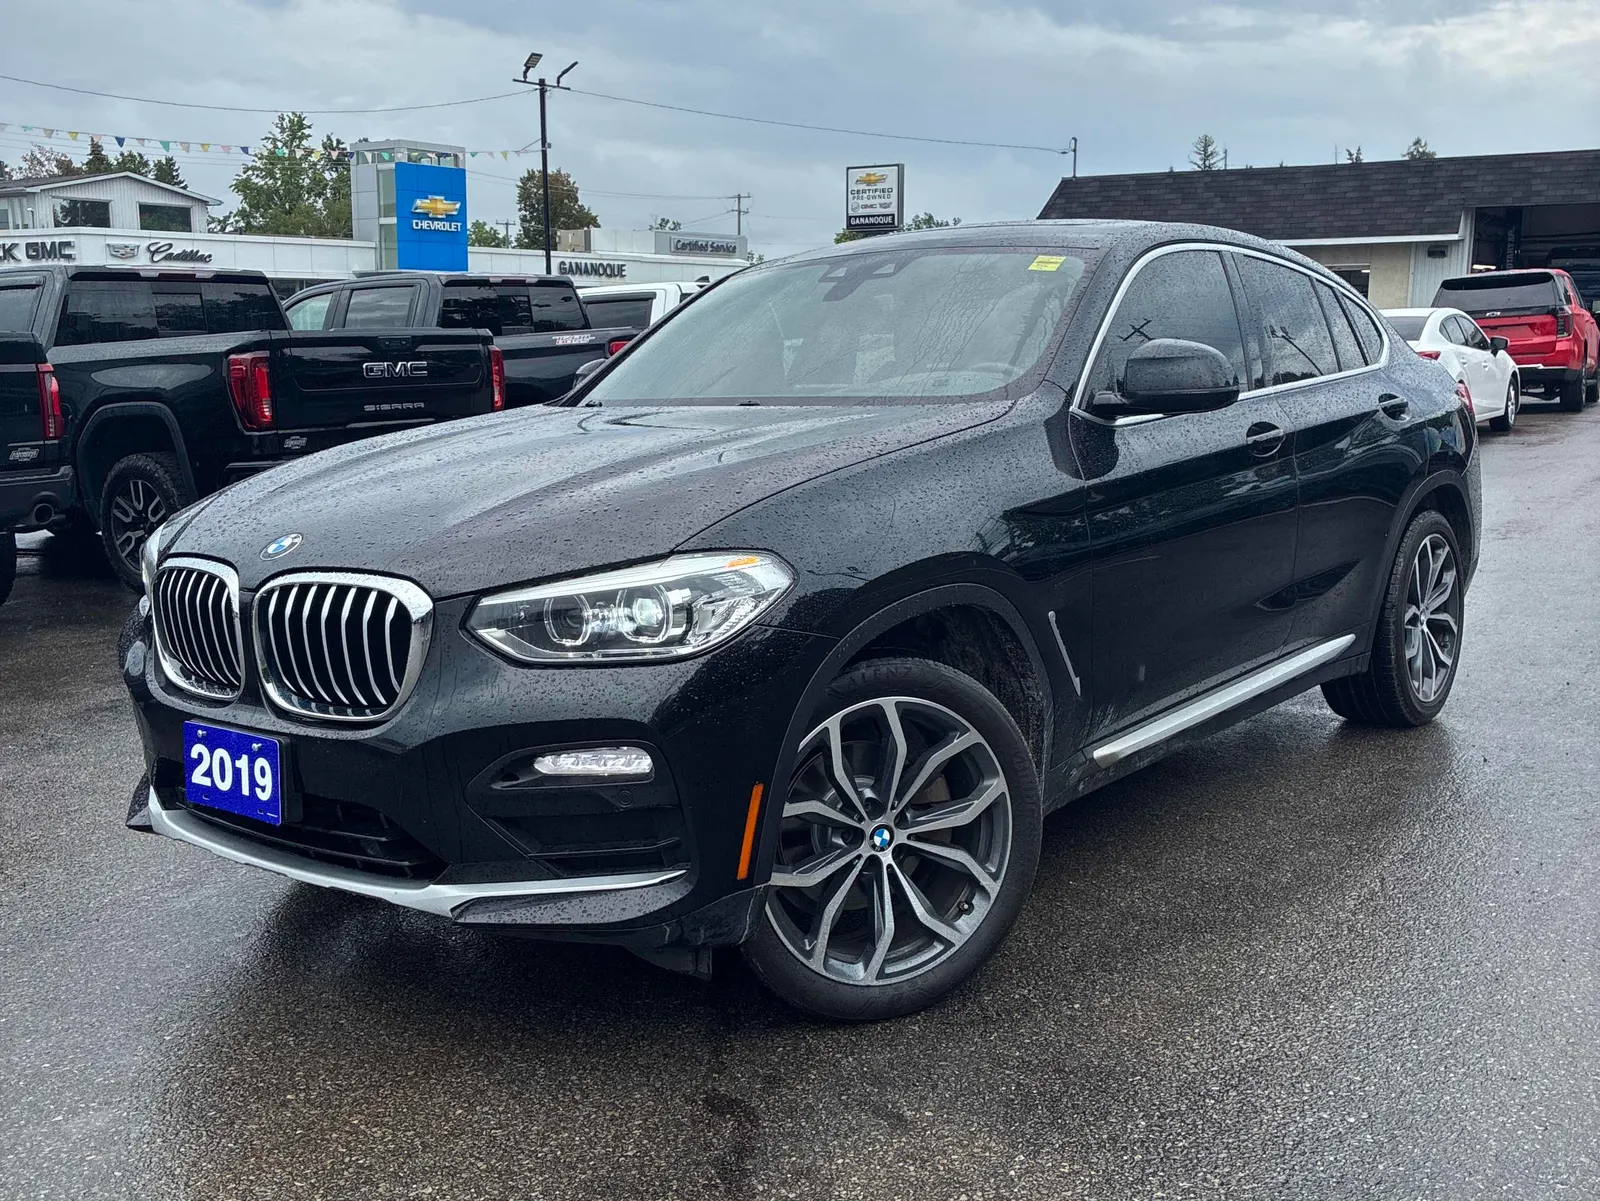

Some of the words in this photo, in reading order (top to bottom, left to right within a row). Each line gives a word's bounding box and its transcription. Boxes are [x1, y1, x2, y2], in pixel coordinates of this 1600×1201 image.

[850, 187, 894, 195] CERTIFIED
[412, 219, 462, 232] CHEVROLET
[850, 216, 893, 225] GANANOQUE
[25, 241, 76, 261] GMC
[146, 241, 213, 263] Cadillac
[675, 239, 708, 252] Certified
[709, 241, 737, 254] Service
[559, 260, 626, 278] GANANOQUE
[363, 361, 428, 378] GMC
[364, 402, 425, 411] SIERRA
[190, 743, 273, 802] 2019
